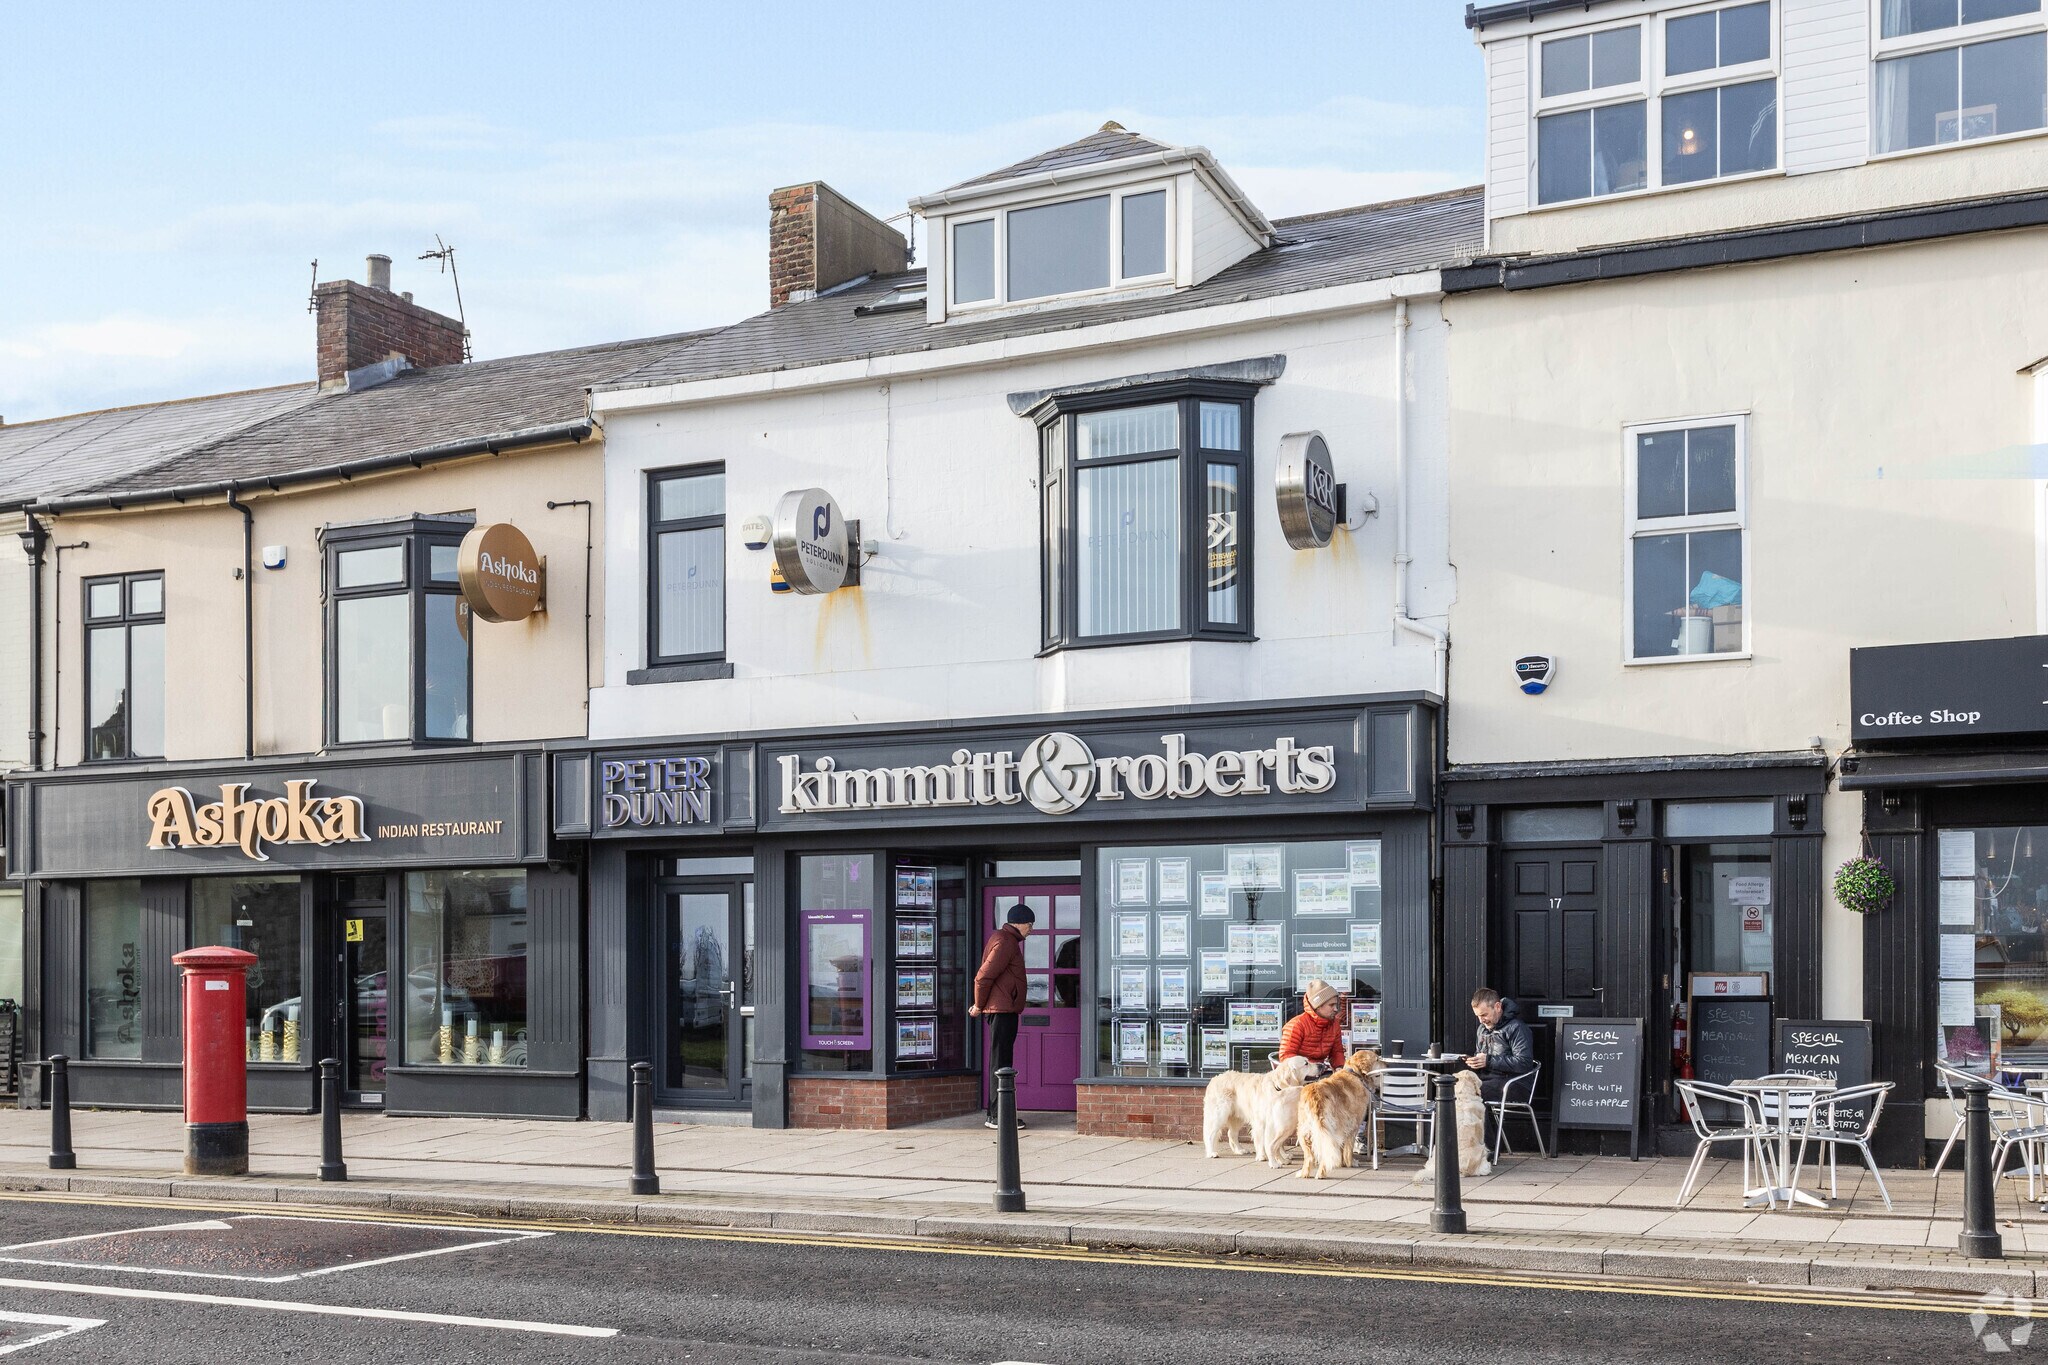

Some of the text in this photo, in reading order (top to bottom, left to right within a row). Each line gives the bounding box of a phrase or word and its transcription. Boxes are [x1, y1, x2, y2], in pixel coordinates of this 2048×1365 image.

[801, 540, 844, 566] PETERDUNN
[481, 552, 537, 583] Ashoka
[1859, 709, 1981, 726] Coffee Shop
[602, 757, 711, 794] PETER
[602, 790, 711, 827] DUNN
[146, 779, 372, 861] Ashoka
[378, 821, 504, 838] INDIAN RESTAURANT
[1550, 897, 1561, 909] 17
[117, 942, 139, 1045] Ashoka
[1715, 983, 1727, 993] illy
[1707, 1008, 1754, 1020] SPECIAL
[1572, 1030, 1619, 1040] SPECIAL
[1791, 1032, 1843, 1044] SPECIAL
[1565, 1052, 1587, 1061] HOG
[1703, 1055, 1746, 1066] CHEESE
[1785, 1053, 1840, 1065] MEXICAN
[1585, 1064, 1603, 1073] PIE
[1597, 1084, 1623, 1092] WITH
[1833, 1120, 1860, 1129] OTATO
